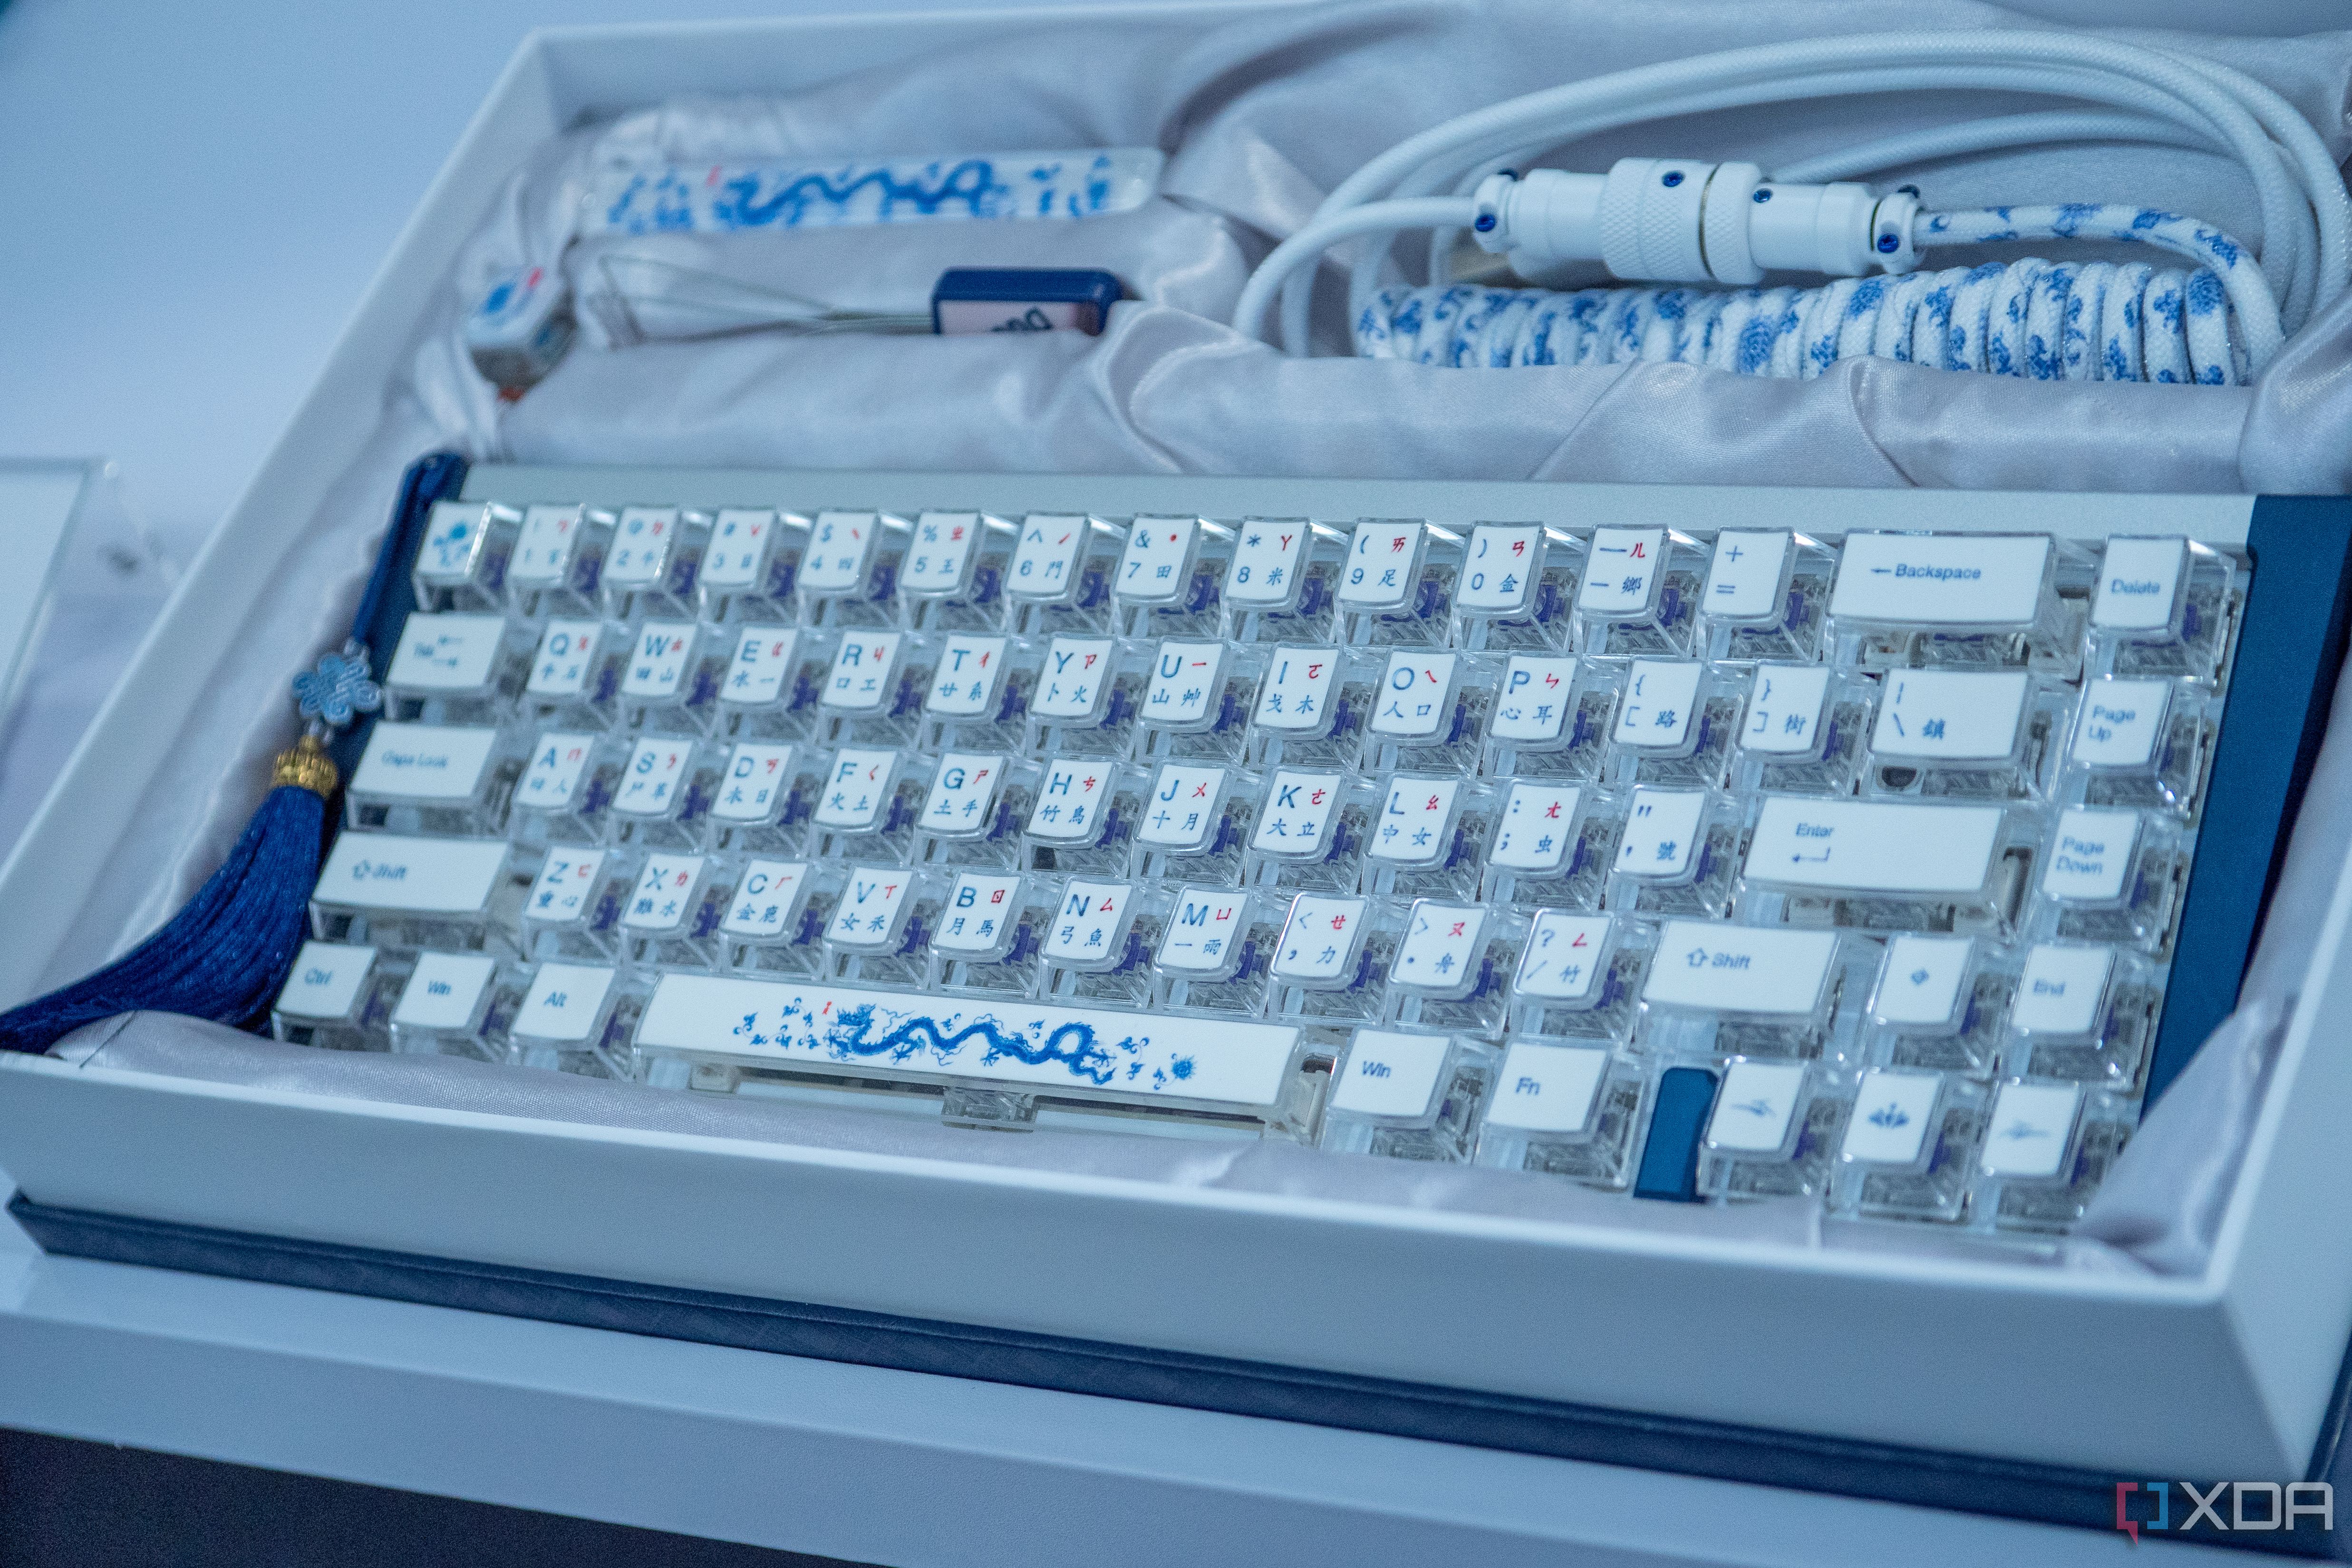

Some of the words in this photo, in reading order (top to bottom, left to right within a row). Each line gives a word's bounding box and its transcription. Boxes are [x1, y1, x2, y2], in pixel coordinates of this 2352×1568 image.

[1135, 531, 1150, 549] &
[811, 556, 823, 571] 4
[915, 556, 928, 573] 5
[1019, 560, 1033, 577] 6
[1128, 562, 1141, 578] 7
[1157, 565, 1171, 578] 田
[1896, 563, 1982, 582] Backspace
[1237, 566, 1250, 584] 8
[1267, 568, 1283, 586] 米
[1351, 568, 1364, 585] 9
[1379, 569, 1396, 587] 足
[1500, 573, 1518, 593] 金
[549, 633, 570, 657] Q
[645, 636, 670, 658] W
[740, 640, 761, 663] E
[842, 644, 863, 667] R
[952, 648, 971, 672] T
[1055, 651, 1074, 674] Y
[1160, 654, 1182, 679] U
[1278, 661, 1288, 685] I
[837, 678, 851, 689] 口
[861, 679, 875, 691] 工
[1392, 667, 1415, 691] O
[1509, 670, 1531, 695] P
[939, 683, 958, 697] 廿
[1047, 683, 1059, 701] 卜
[1072, 686, 1087, 704] 火
[1152, 688, 1170, 704] 山
[1267, 693, 1282, 713] 戈
[1296, 695, 1314, 714] 木
[1384, 701, 1403, 718] 人
[1417, 704, 1432, 716] 口
[1500, 709, 1521, 720] 心
[1533, 705, 1552, 725] 耳
[539, 747, 557, 768] A
[636, 752, 656, 774] S
[734, 756, 755, 779] D
[836, 762, 858, 783] F
[943, 768, 966, 790] G
[1049, 772, 1073, 795] H
[1160, 779, 1180, 802] J
[828, 793, 844, 811] 火
[1277, 784, 1302, 809] K
[1389, 792, 1405, 815] L
[934, 799, 951, 815] 土
[963, 800, 977, 817] 手
[1041, 805, 1060, 823] 竹
[1069, 805, 1084, 824] 鳥
[1153, 810, 1171, 829] 十
[1182, 813, 1199, 831] 月
[1268, 818, 1286, 836] 大
[1297, 822, 1315, 836] 立
[1795, 823, 1835, 837] Enter
[1383, 824, 1399, 843] 中
[1413, 827, 1432, 846] 女
[1535, 835, 1553, 853] 虫
[547, 862, 569, 883] Z
[645, 868, 668, 890] X
[747, 873, 768, 895] C
[857, 881, 876, 904] V
[956, 886, 977, 908] B
[1066, 894, 1090, 917] N
[842, 913, 860, 931] 女
[869, 915, 884, 932] 禾
[1181, 903, 1209, 927] M
[952, 918, 965, 935] 月
[977, 920, 994, 937] 馬
[1061, 926, 1074, 944] 弓
[1084, 929, 1102, 947] 魚
[1204, 939, 1221, 955] 雨
[1541, 929, 1555, 948] ?
[1317, 946, 1336, 964] 力
[1436, 953, 1455, 974] 舟
[1712, 952, 1751, 970] Shift
[1560, 965, 1580, 984] 竹
[1362, 1061, 1391, 1078] Win
[1515, 1076, 1541, 1095] Fn
